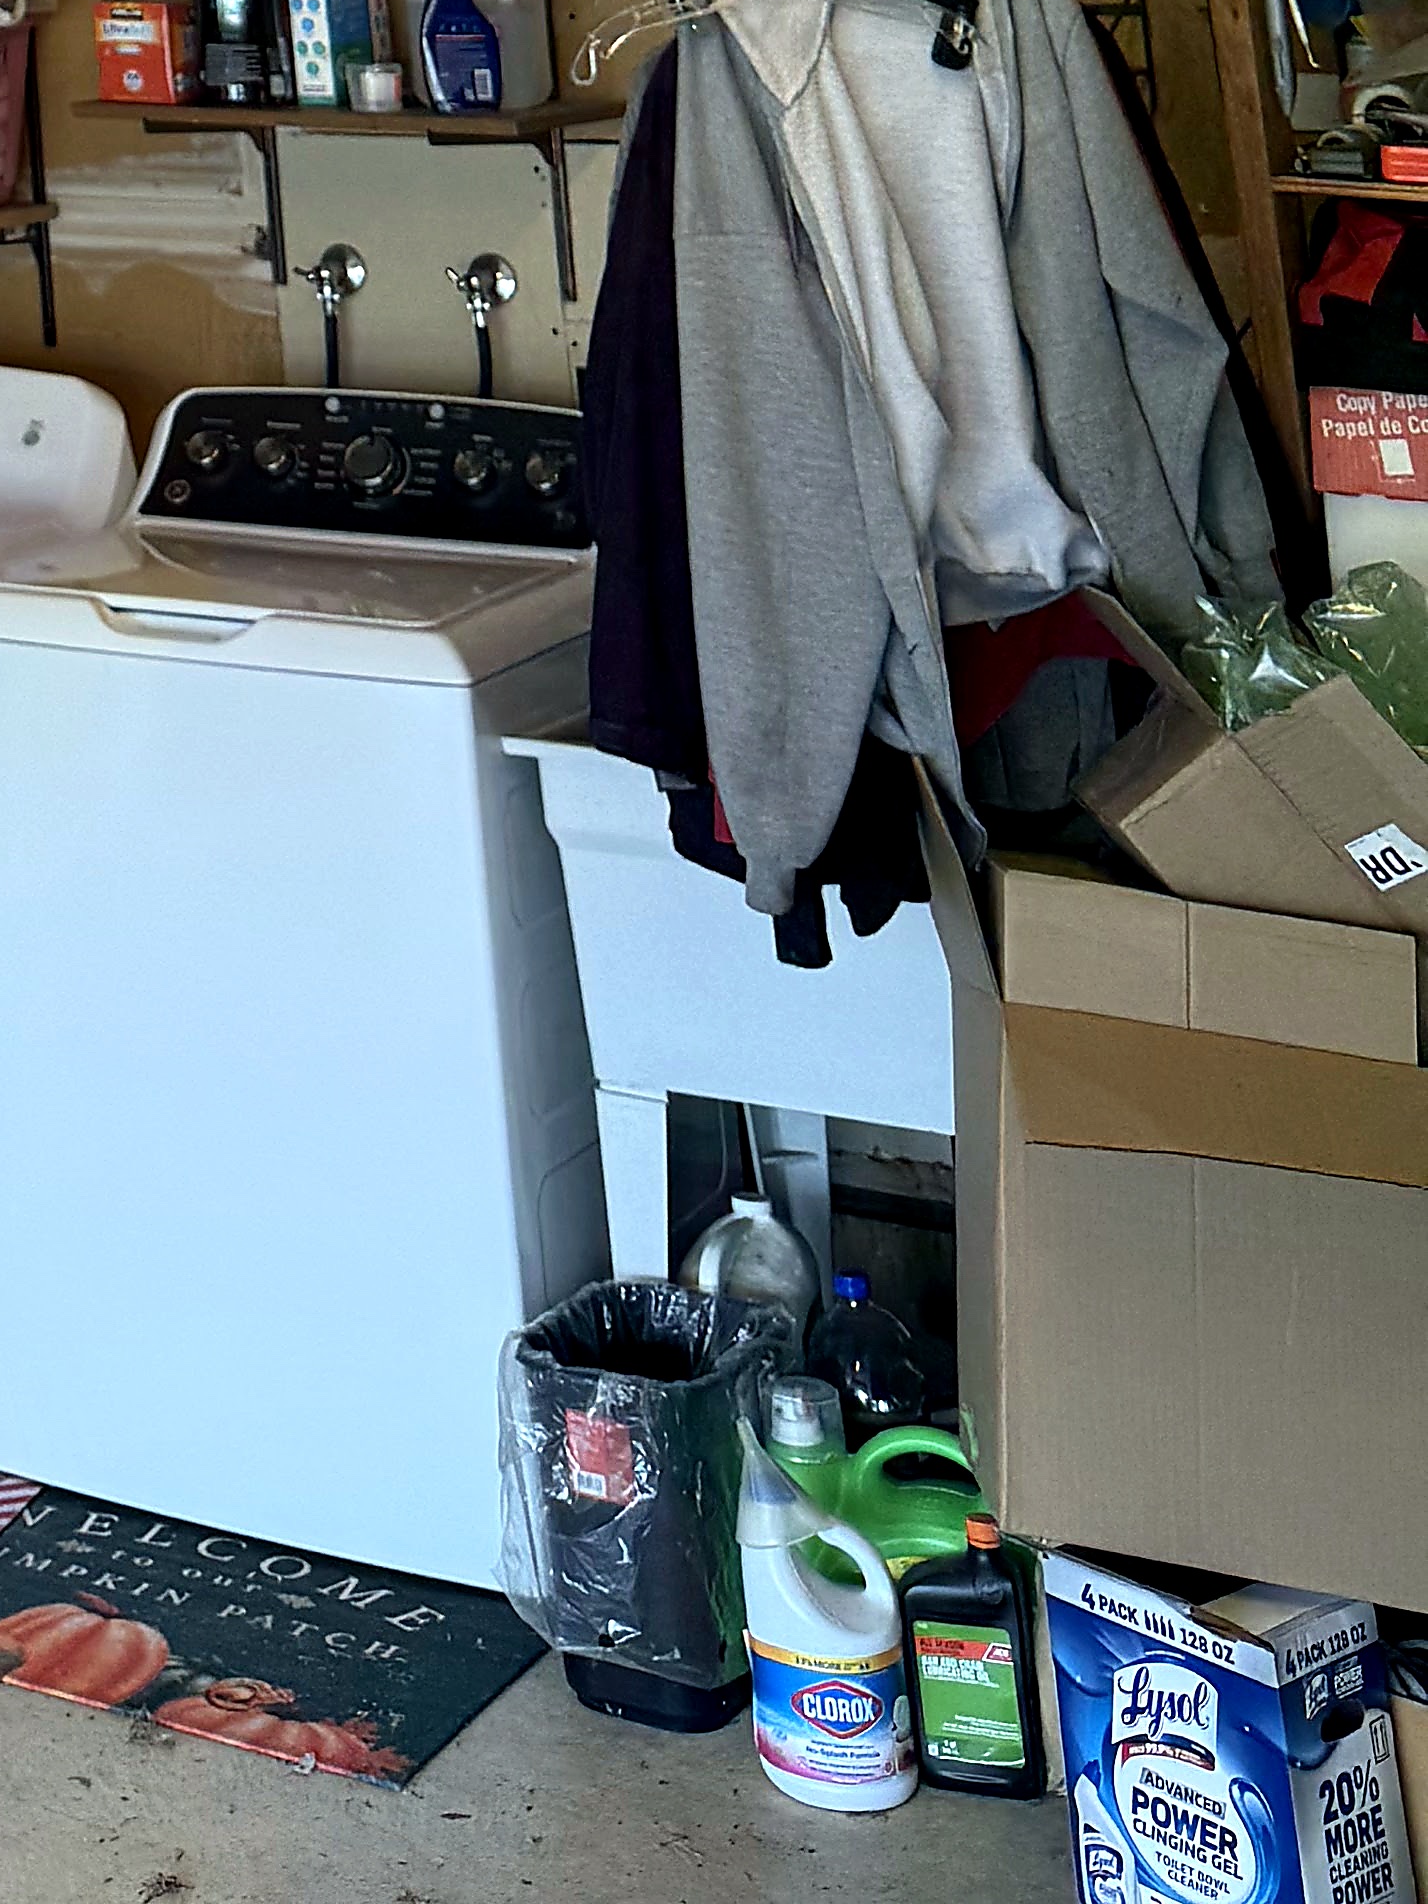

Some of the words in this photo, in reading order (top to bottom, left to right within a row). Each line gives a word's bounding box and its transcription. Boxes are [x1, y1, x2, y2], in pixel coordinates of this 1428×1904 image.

[1321, 417, 1375, 440] Papel
[1380, 416, 1403, 436] de
[1336, 393, 1376, 415] Copy
[111, 1548, 154, 1567] to
[217, 1603, 410, 1662] PATCH
[1081, 1583, 1096, 1611] 4
[1098, 1593, 1140, 1626] PACK
[1180, 1626, 1209, 1654] 128
[1211, 1642, 1236, 1666] OZ
[1286, 1649, 1297, 1678] 4
[1296, 1641, 1329, 1674] PACK
[1327, 1629, 1350, 1657] 128
[1350, 1622, 1368, 1644] OZ
[803, 1693, 875, 1723] CLOROX
[1118, 1667, 1210, 1740] Lysol
[1143, 1769, 1225, 1817] ADVANCED
[1318, 1758, 1380, 1825] 20%
[1132, 1787, 1238, 1858] POWER
[1324, 1803, 1386, 1864] MORE
[1134, 1817, 1208, 1866] CLINGING
[1211, 1855, 1243, 1881] GEL
[1156, 1850, 1196, 1879] TOILET
[1197, 1872, 1231, 1895] BOWL
[1329, 1840, 1389, 1884] CLEANING
[1167, 1870, 1219, 1901] CLEANER
[1332, 1862, 1394, 1904] POWER
